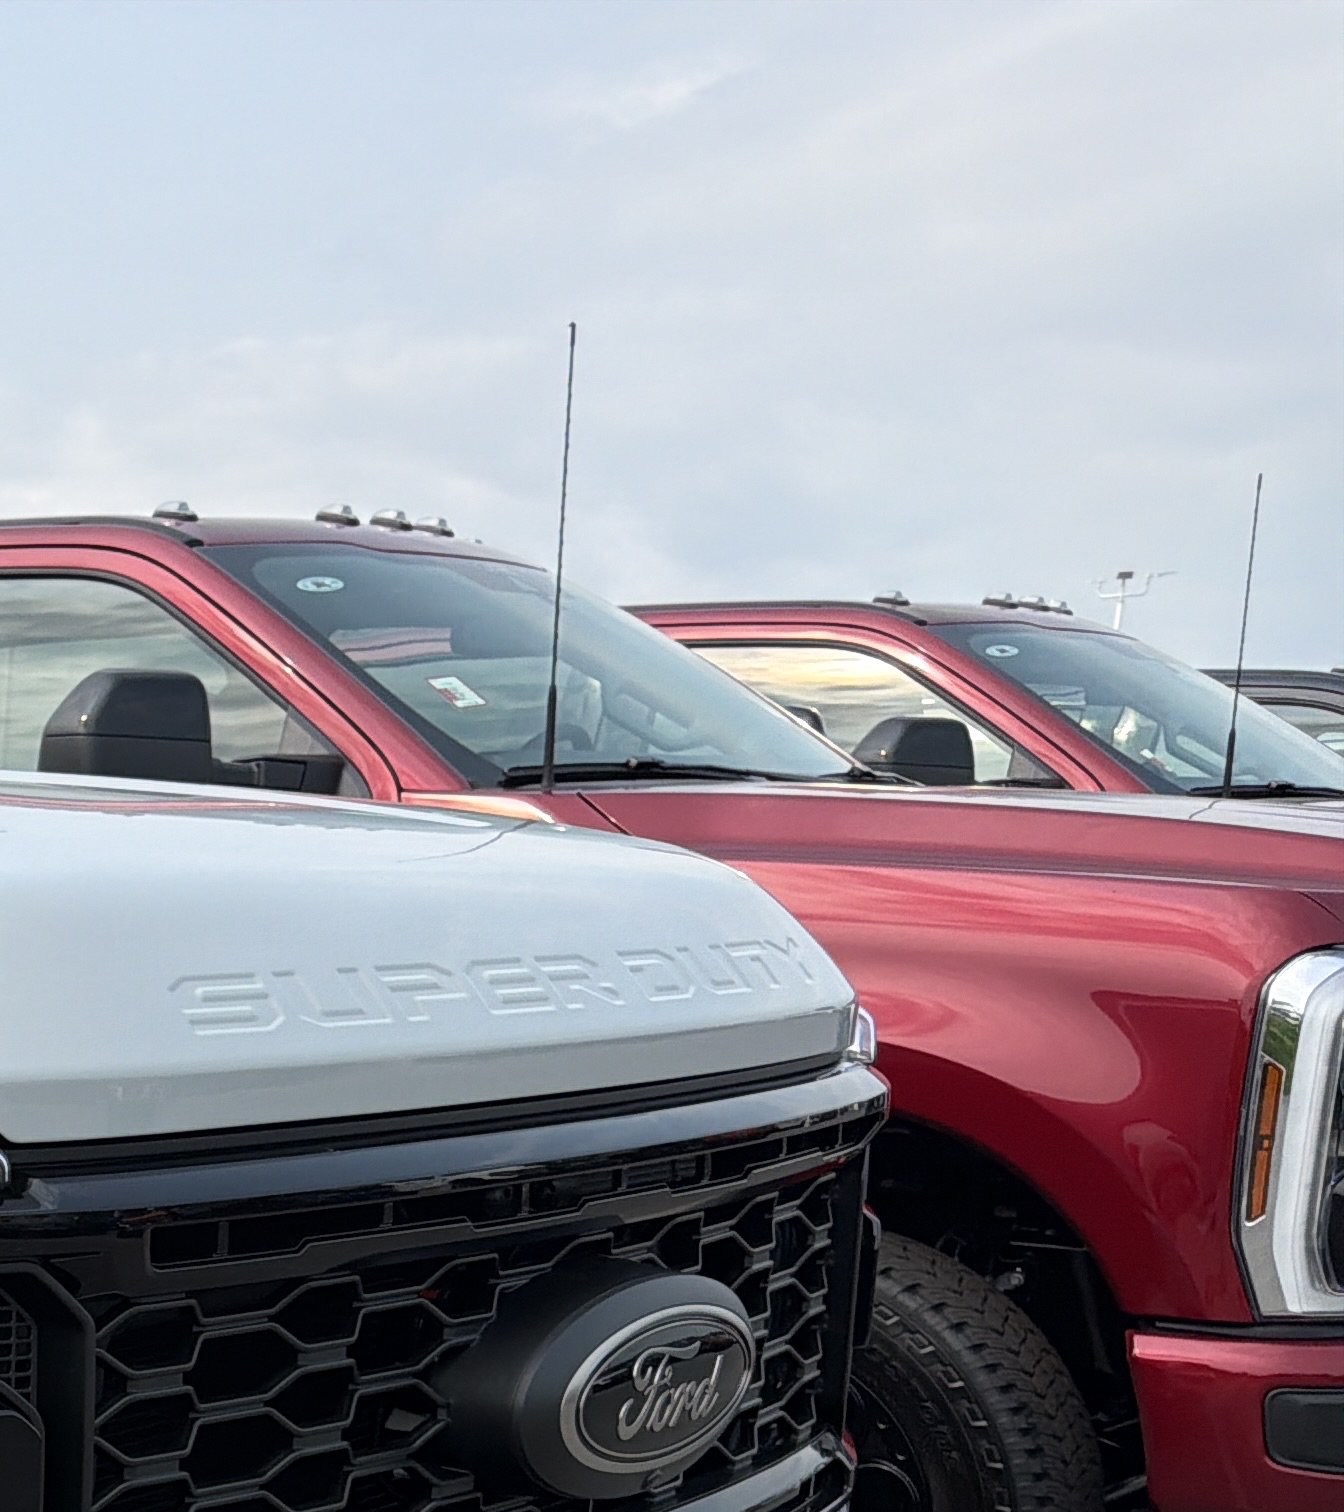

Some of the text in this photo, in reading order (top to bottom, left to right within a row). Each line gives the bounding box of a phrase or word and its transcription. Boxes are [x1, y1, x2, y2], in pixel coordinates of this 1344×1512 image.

[168, 935, 814, 1037] SUPER DUTY
[616, 1339, 725, 1442] Ford
